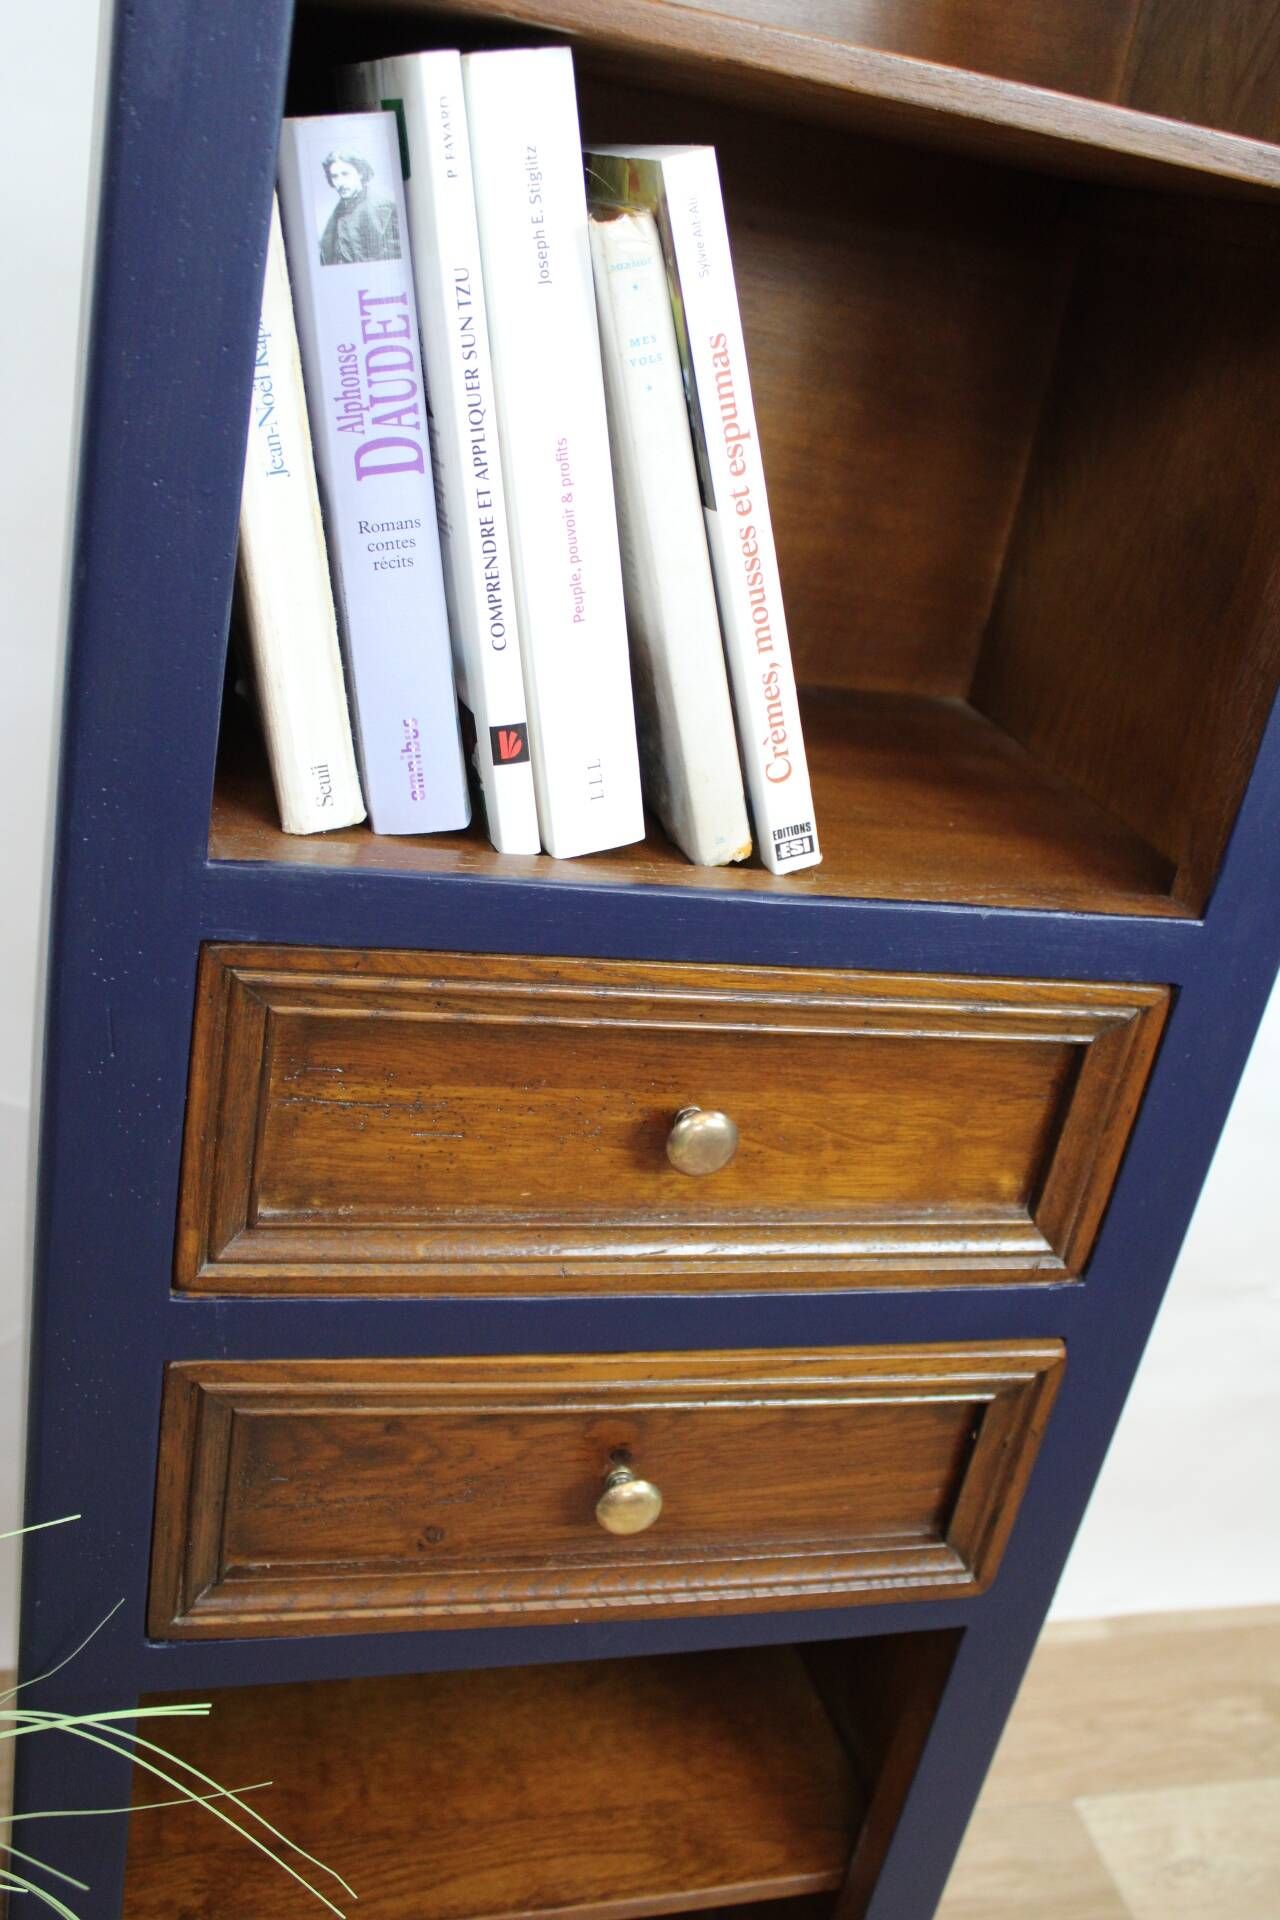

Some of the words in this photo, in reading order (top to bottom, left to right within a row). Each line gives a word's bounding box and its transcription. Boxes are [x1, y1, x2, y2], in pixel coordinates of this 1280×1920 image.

[526, 144, 544, 205] Stiglitz
[531, 208, 545, 225] E.
[532, 229, 553, 286] Joseph
[453, 266, 474, 311] TZU
[459, 315, 479, 360] SUN
[628, 334, 658, 349] MES
[628, 353, 664, 369] VOLS
[336, 342, 362, 436] Alphonse
[354, 288, 426, 482] DAUDET
[708, 332, 752, 477] espumas
[254, 374, 291, 478] Jean-Noël
[464, 367, 491, 481] APPLIQUER
[556, 437, 573, 488] profits
[476, 488, 493, 509] ET
[560, 491, 573, 505] &
[730, 485, 755, 517] et
[357, 517, 422, 535] Romans
[367, 536, 417, 553] contes
[563, 508, 582, 565] pouvoir
[372, 555, 415, 572] récits
[478, 516, 508, 652] COMPRENDRE
[569, 567, 586, 625] Peuple,
[738, 524, 775, 656] mousses
[762, 660, 793, 785] Crèmes,
[772, 820, 812, 842] EDITIONS
